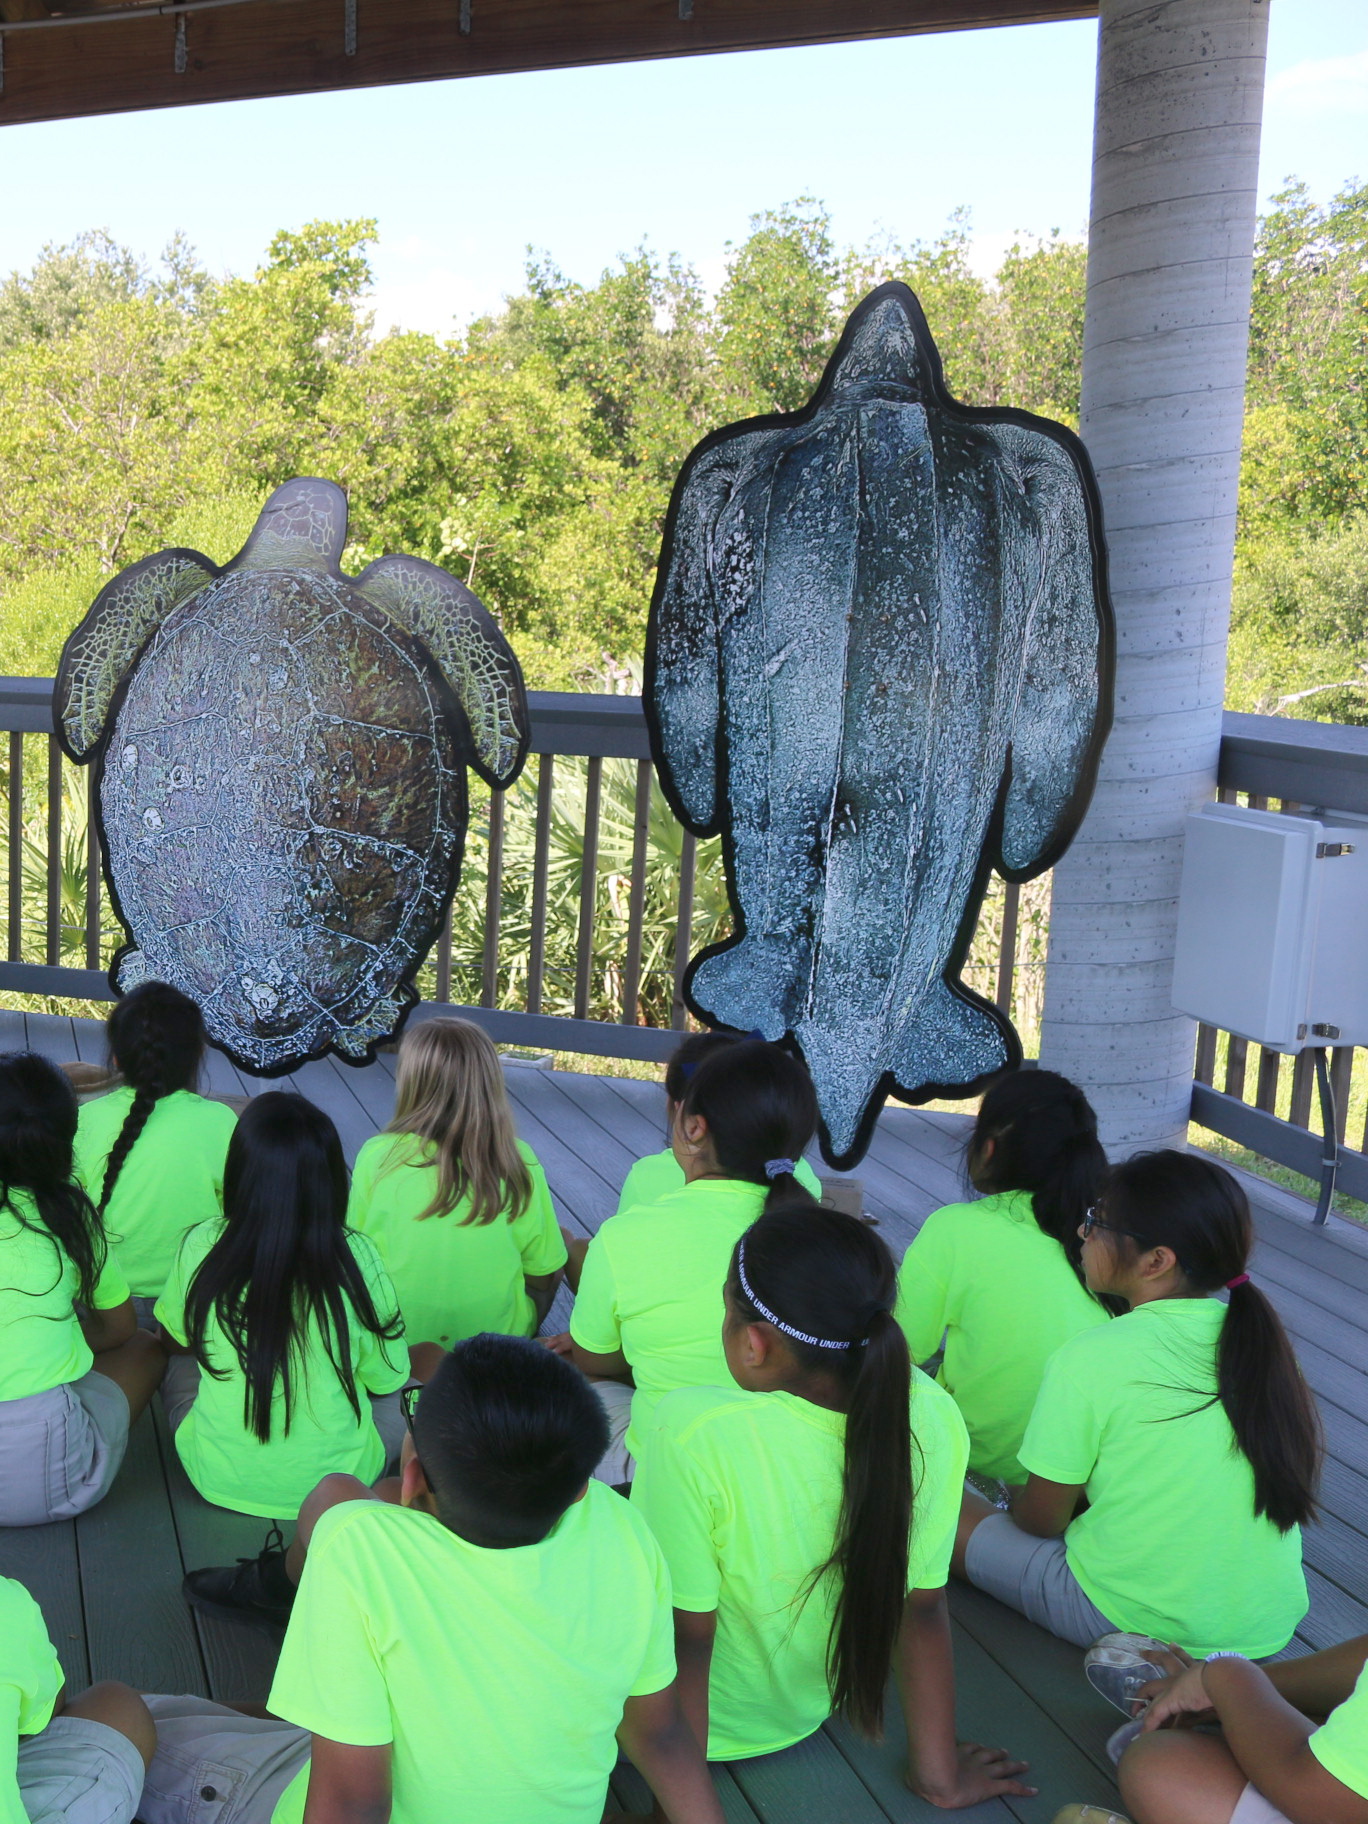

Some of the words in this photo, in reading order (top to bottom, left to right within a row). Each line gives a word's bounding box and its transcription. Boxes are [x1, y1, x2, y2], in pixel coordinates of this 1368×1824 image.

[738, 1263, 755, 1300] ARMOUR
[753, 1298, 779, 1325] UNDER
[778, 1322, 819, 1345] ARMOUR
[819, 1339, 850, 1349] UNDER
